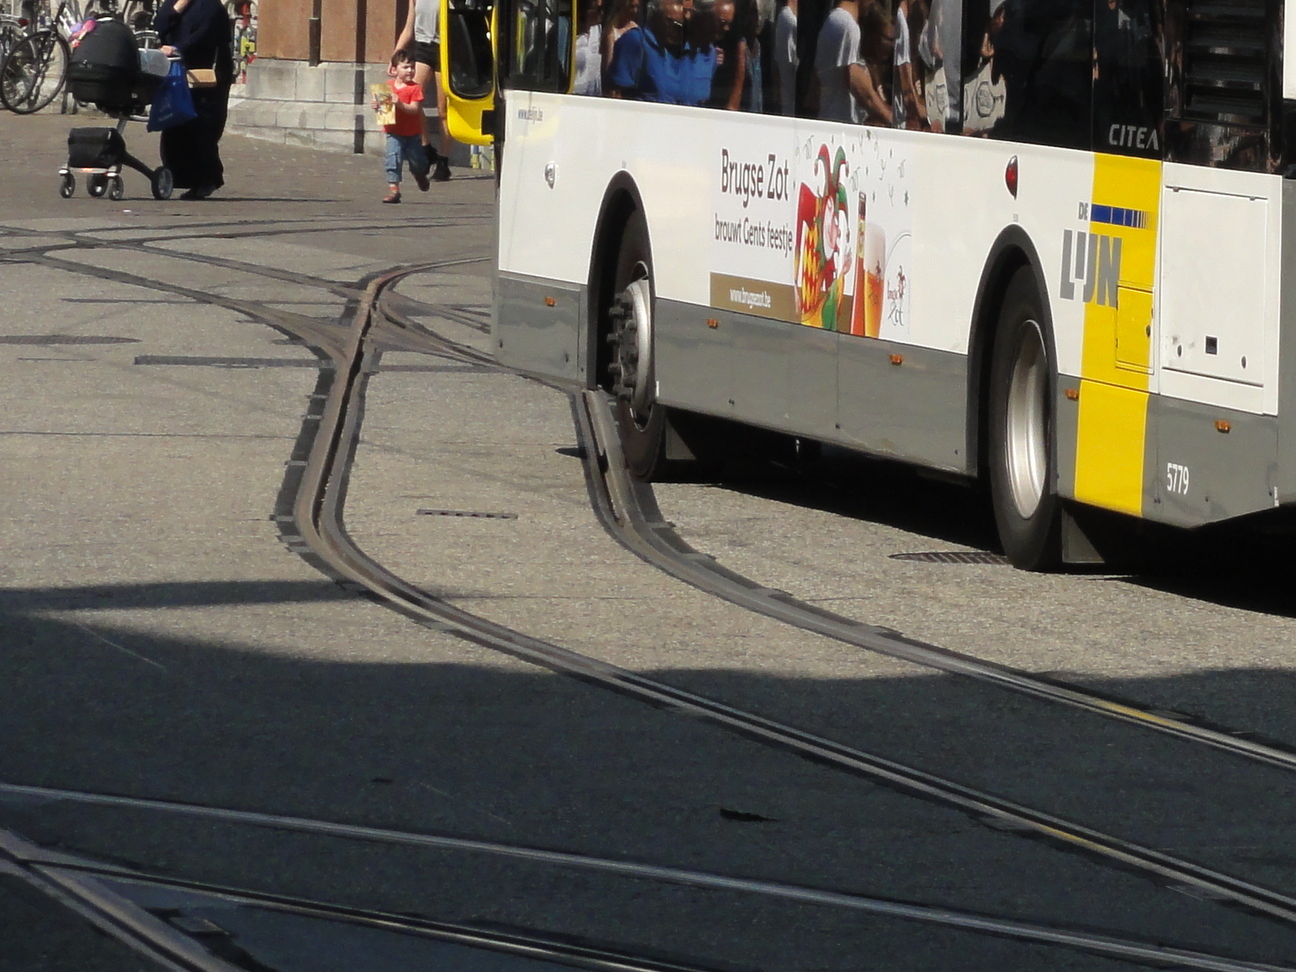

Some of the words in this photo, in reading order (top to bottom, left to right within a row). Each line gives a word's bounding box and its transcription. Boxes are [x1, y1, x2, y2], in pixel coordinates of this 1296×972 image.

[1108, 124, 1160, 151] CITEA
[721, 147, 764, 208] Brugse
[767, 153, 790, 202] Zot
[1078, 201, 1089, 221] DE
[715, 212, 742, 245] brouwt
[743, 216, 766, 249] Gents
[767, 219, 794, 259] feestje
[1060, 228, 1123, 308] LIJN
[1166, 462, 1190, 496] 5779
